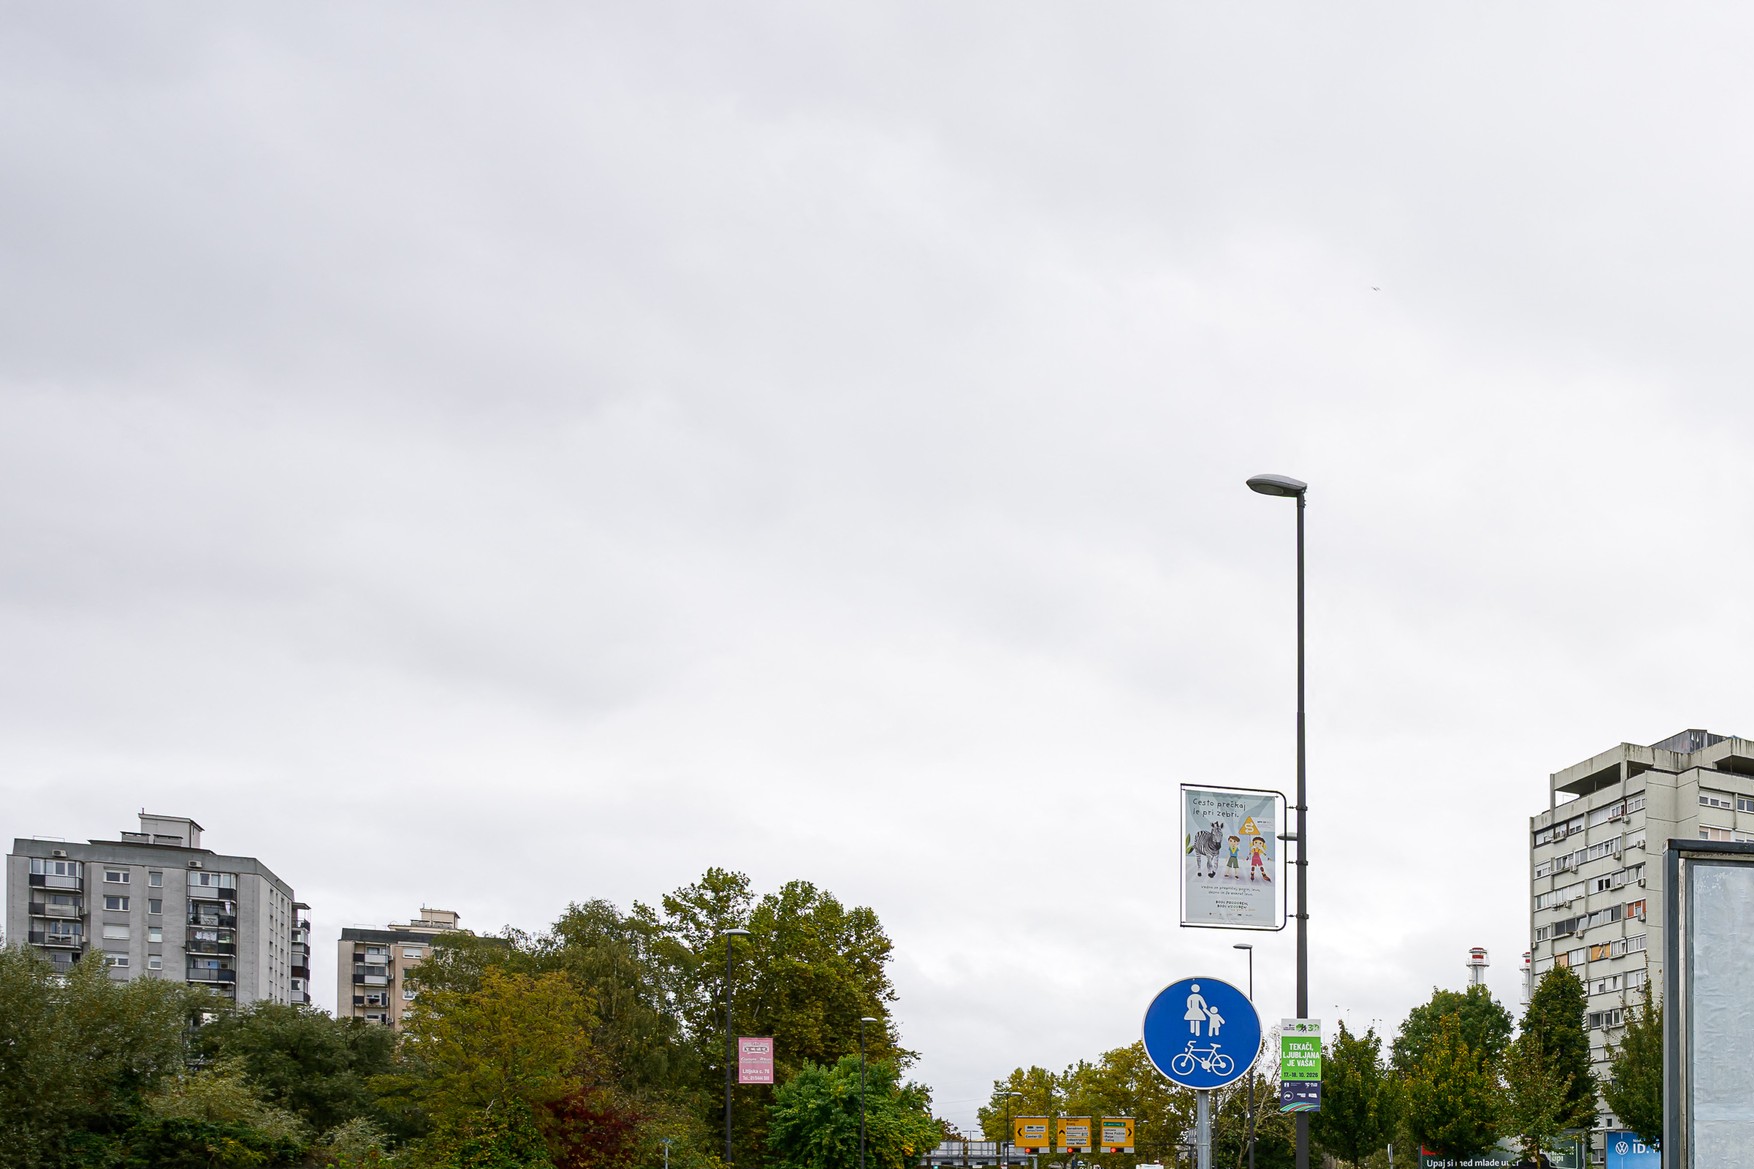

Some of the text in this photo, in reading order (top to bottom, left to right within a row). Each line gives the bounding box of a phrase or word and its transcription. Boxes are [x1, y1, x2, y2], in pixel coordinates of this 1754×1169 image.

[1289, 1041, 1314, 1051] TEKAČI,
[1283, 1051, 1320, 1059] LJUBLJANA
[1296, 1058, 1316, 1067] VAŠA!
[1426, 1158, 1446, 1169] Upaj
[1447, 1158, 1454, 1167] si
[1474, 1158, 1499, 1167] mlade
